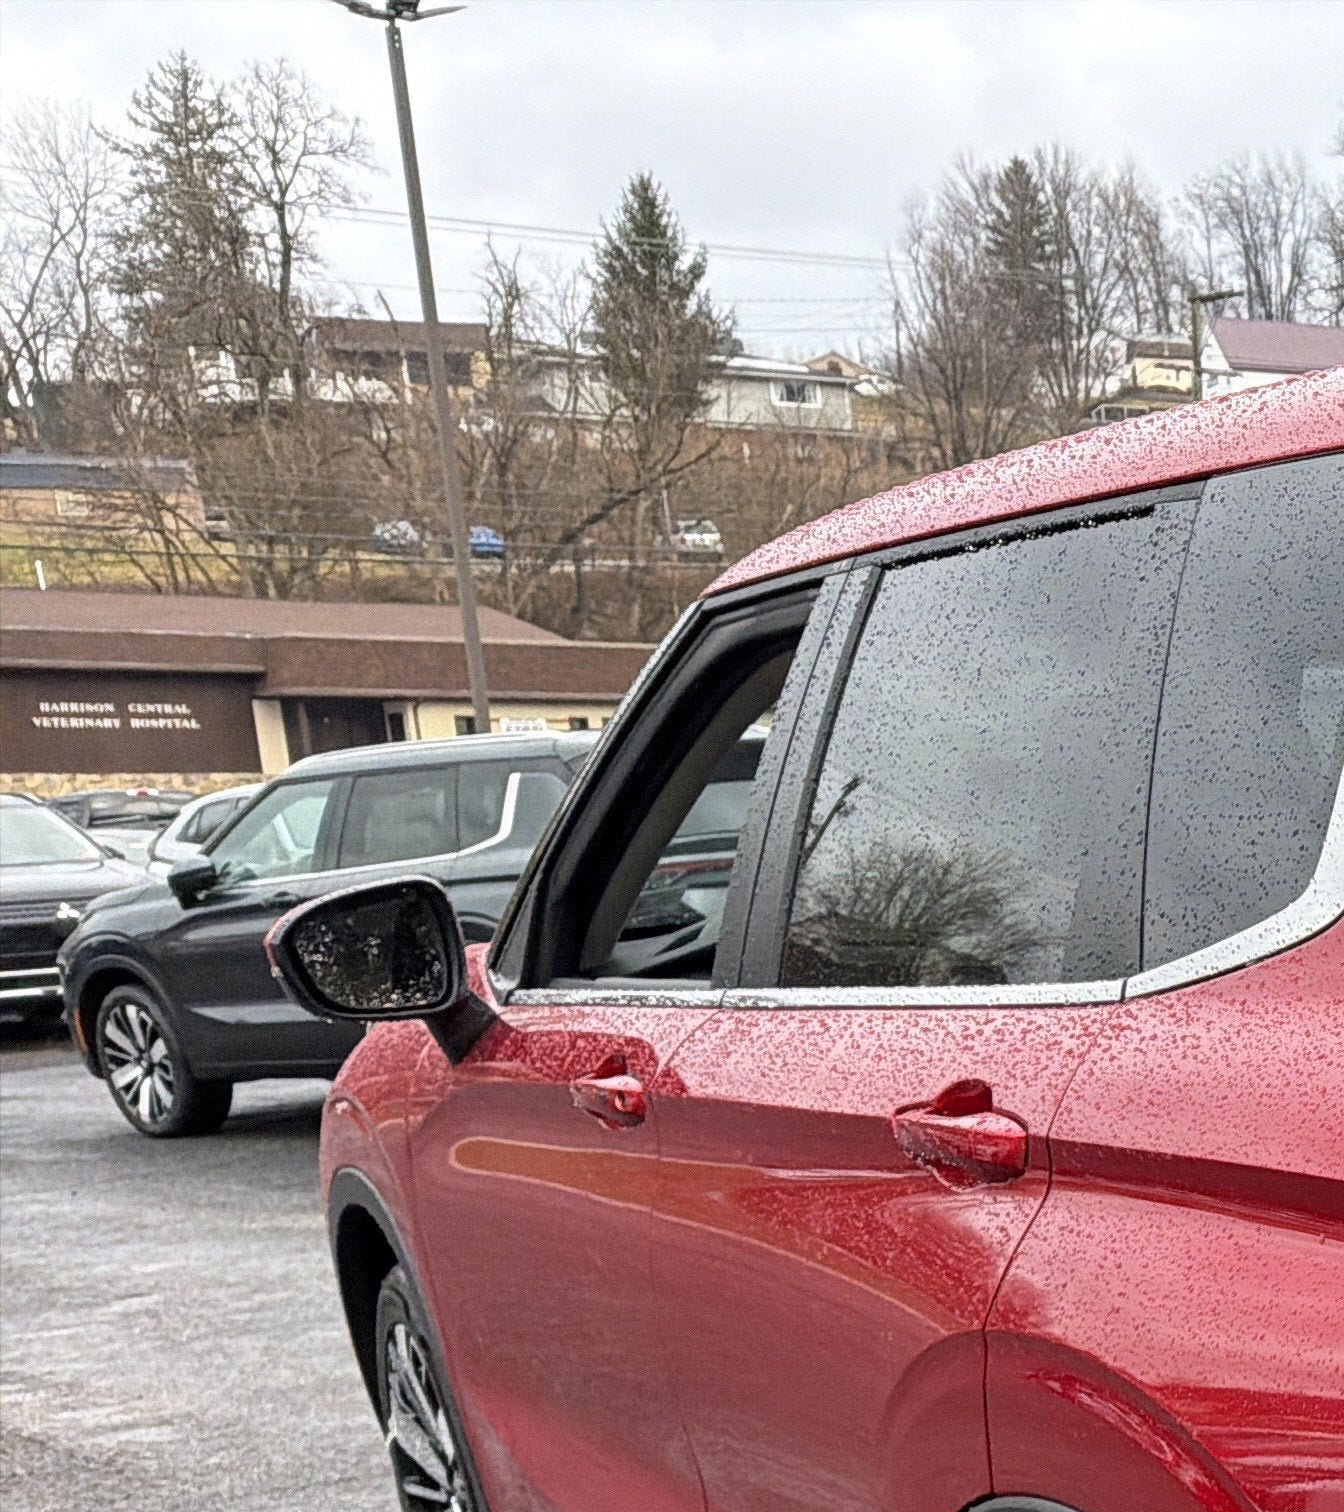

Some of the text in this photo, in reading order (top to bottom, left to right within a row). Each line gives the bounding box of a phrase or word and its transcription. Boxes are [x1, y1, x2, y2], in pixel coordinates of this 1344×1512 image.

[128, 703, 191, 714] CENTRAL
[32, 717, 200, 730] VETERINARY HOSPITAL
